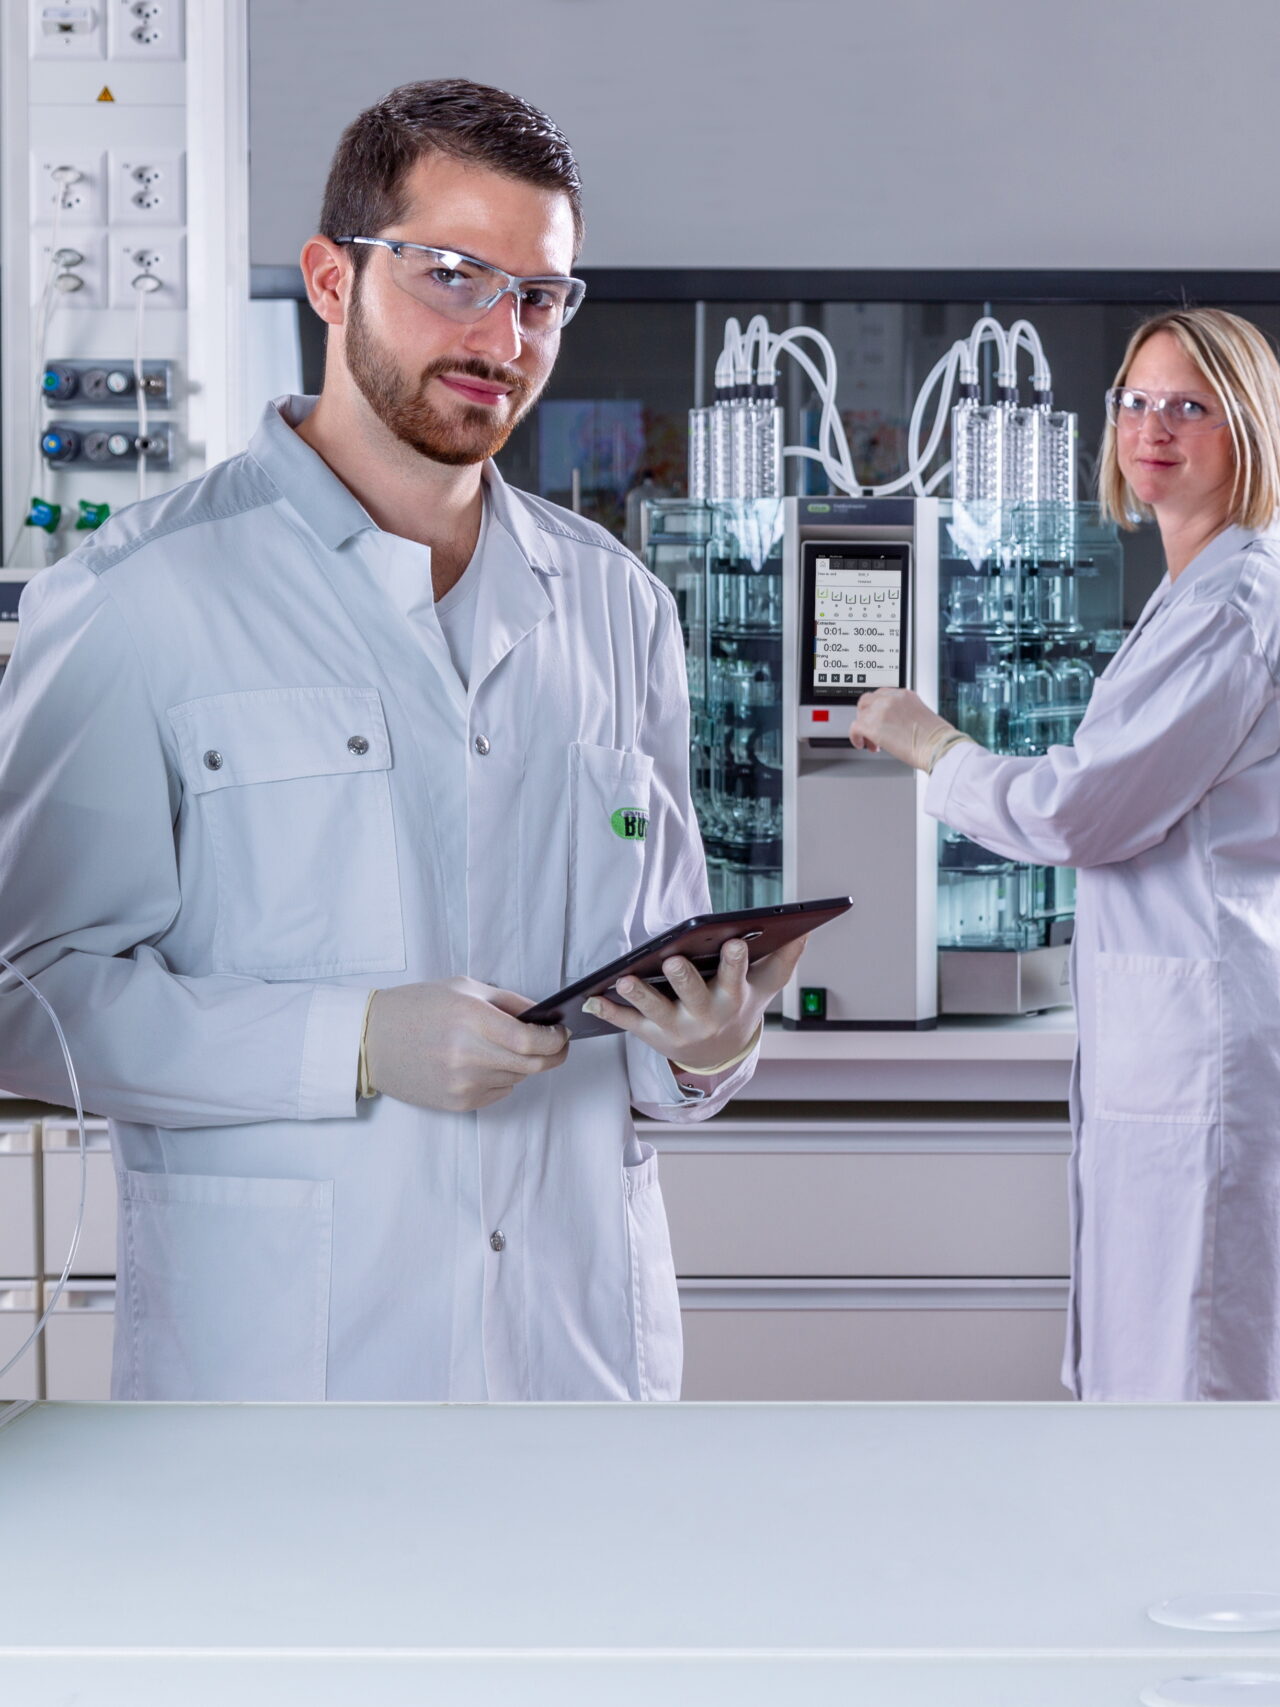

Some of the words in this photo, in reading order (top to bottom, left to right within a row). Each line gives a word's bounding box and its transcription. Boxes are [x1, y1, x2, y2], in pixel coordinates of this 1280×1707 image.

[823, 627, 842, 635] 0:01
[853, 628, 878, 636] 30:00
[823, 643, 842, 652] 0:02
[858, 644, 877, 652] 5:00
[823, 660, 842, 668] 0:00
